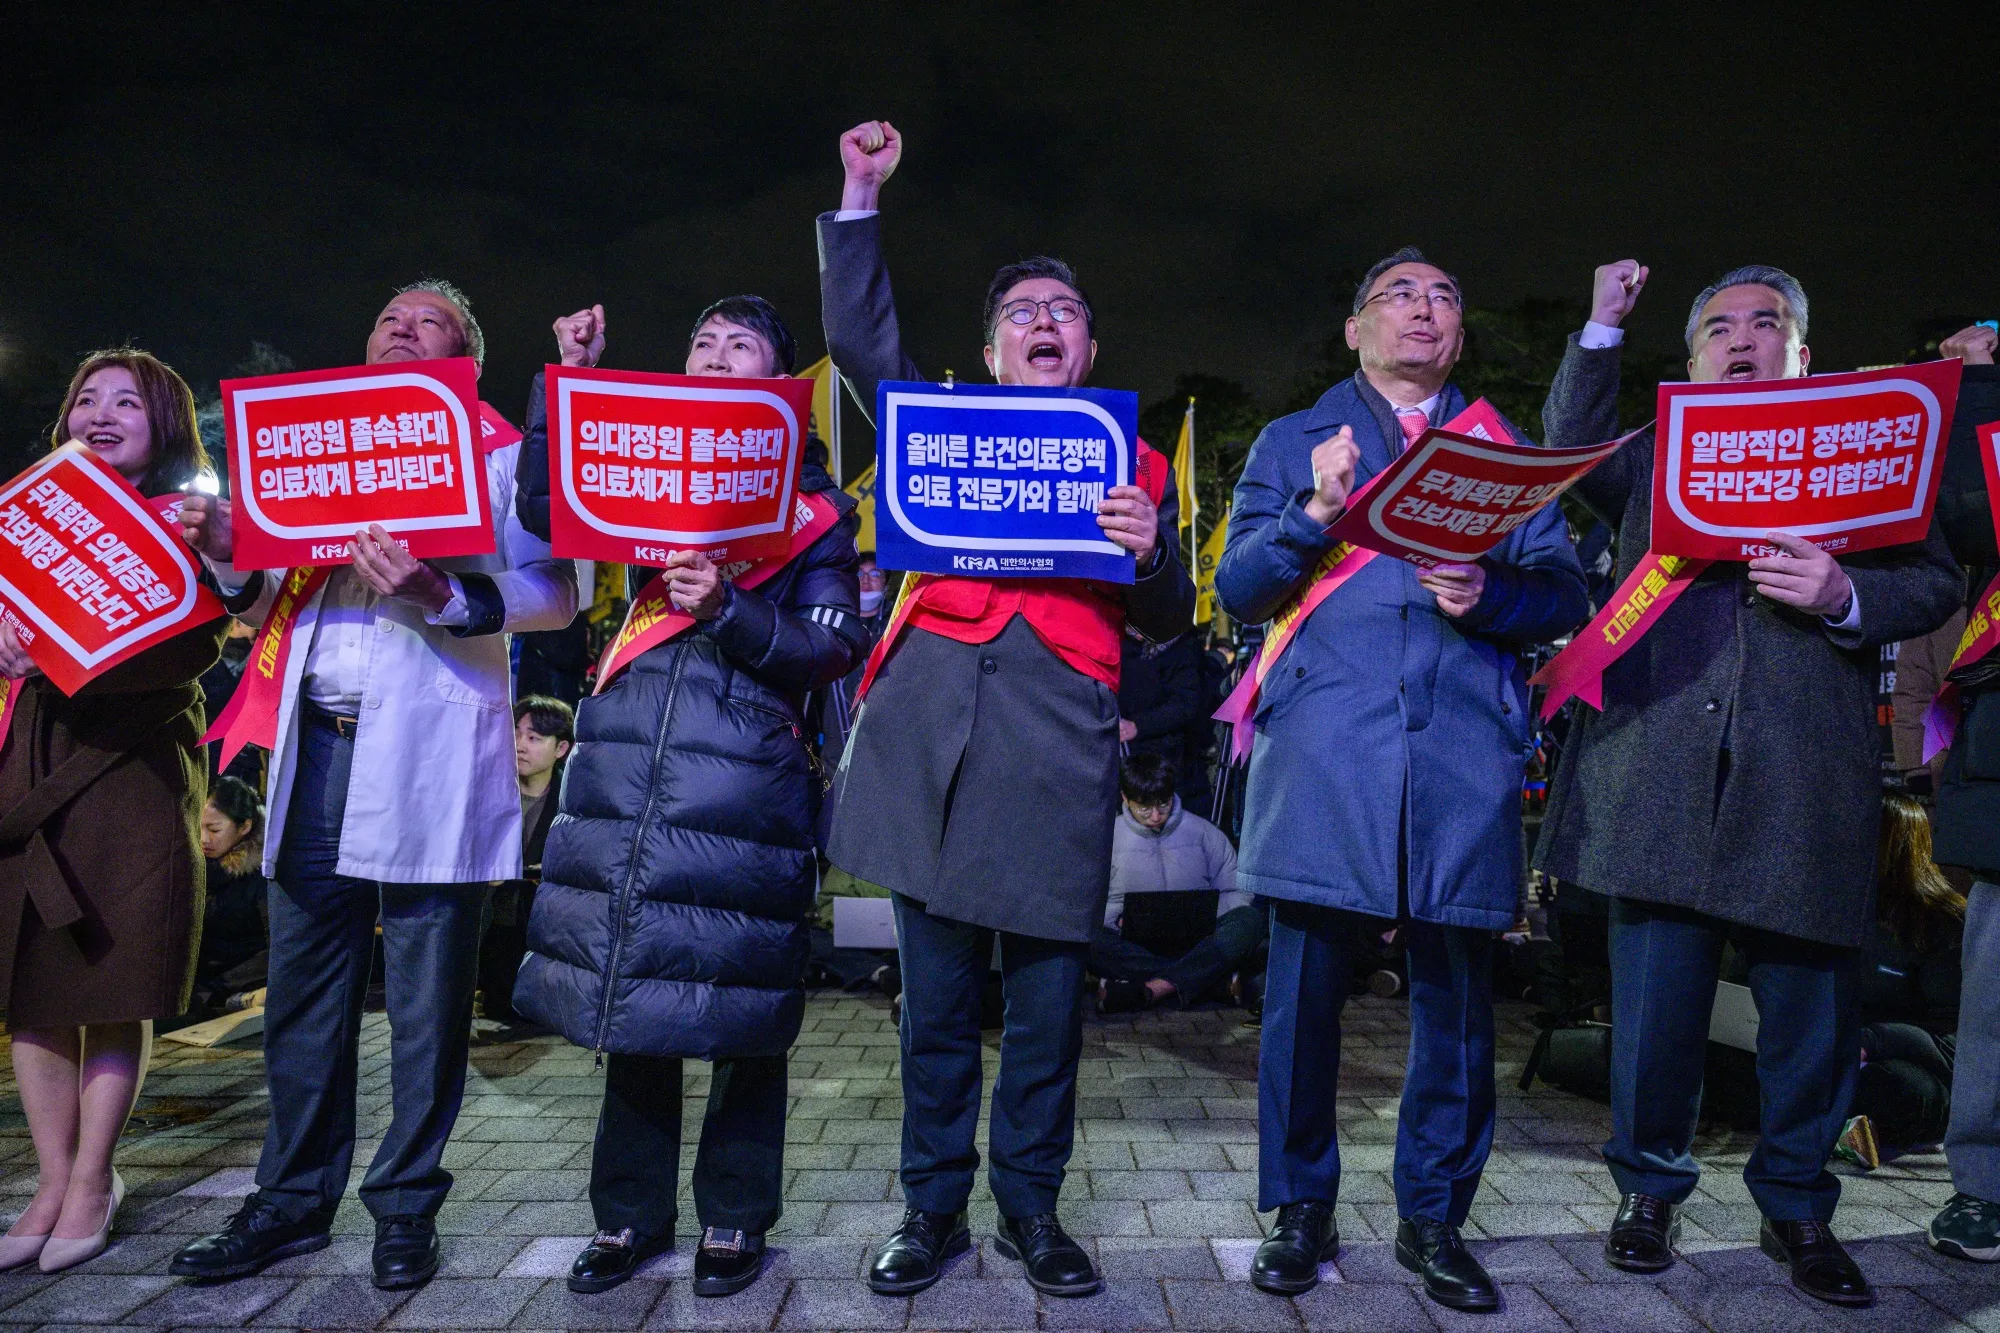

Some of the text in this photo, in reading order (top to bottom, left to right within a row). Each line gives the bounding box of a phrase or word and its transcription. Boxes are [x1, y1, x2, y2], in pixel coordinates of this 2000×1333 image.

[256, 419, 346, 459] 의대정원
[350, 411, 449, 452] 졸속확대
[580, 421, 784, 462] 의대정원 졸속확대
[907, 432, 1106, 473] 올바른 보건의료정책
[1691, 413, 1921, 463] 일방적인 정책추진
[260, 453, 454, 500] 의료체계 붕괴된다
[581, 463, 779, 505] 의료체계 붕괴된다
[908, 475, 952, 507] 의료
[957, 477, 1051, 513] 전문가와
[1056, 480, 1104, 514] 함께
[1416, 469, 1526, 508] 무계획적
[1688, 454, 1913, 502] 국민건강 위협한다
[1391, 496, 1500, 536] 건보재정
[26, 479, 177, 612] 무계획적 의대증원
[954, 556, 999, 570] KMA
[1001, 558, 1054, 567] 대한의사협회
[49, 555, 140, 632] 파탄난다
[1602, 568, 1668, 645] 붕괴된다
[615, 597, 669, 656] 국민건
